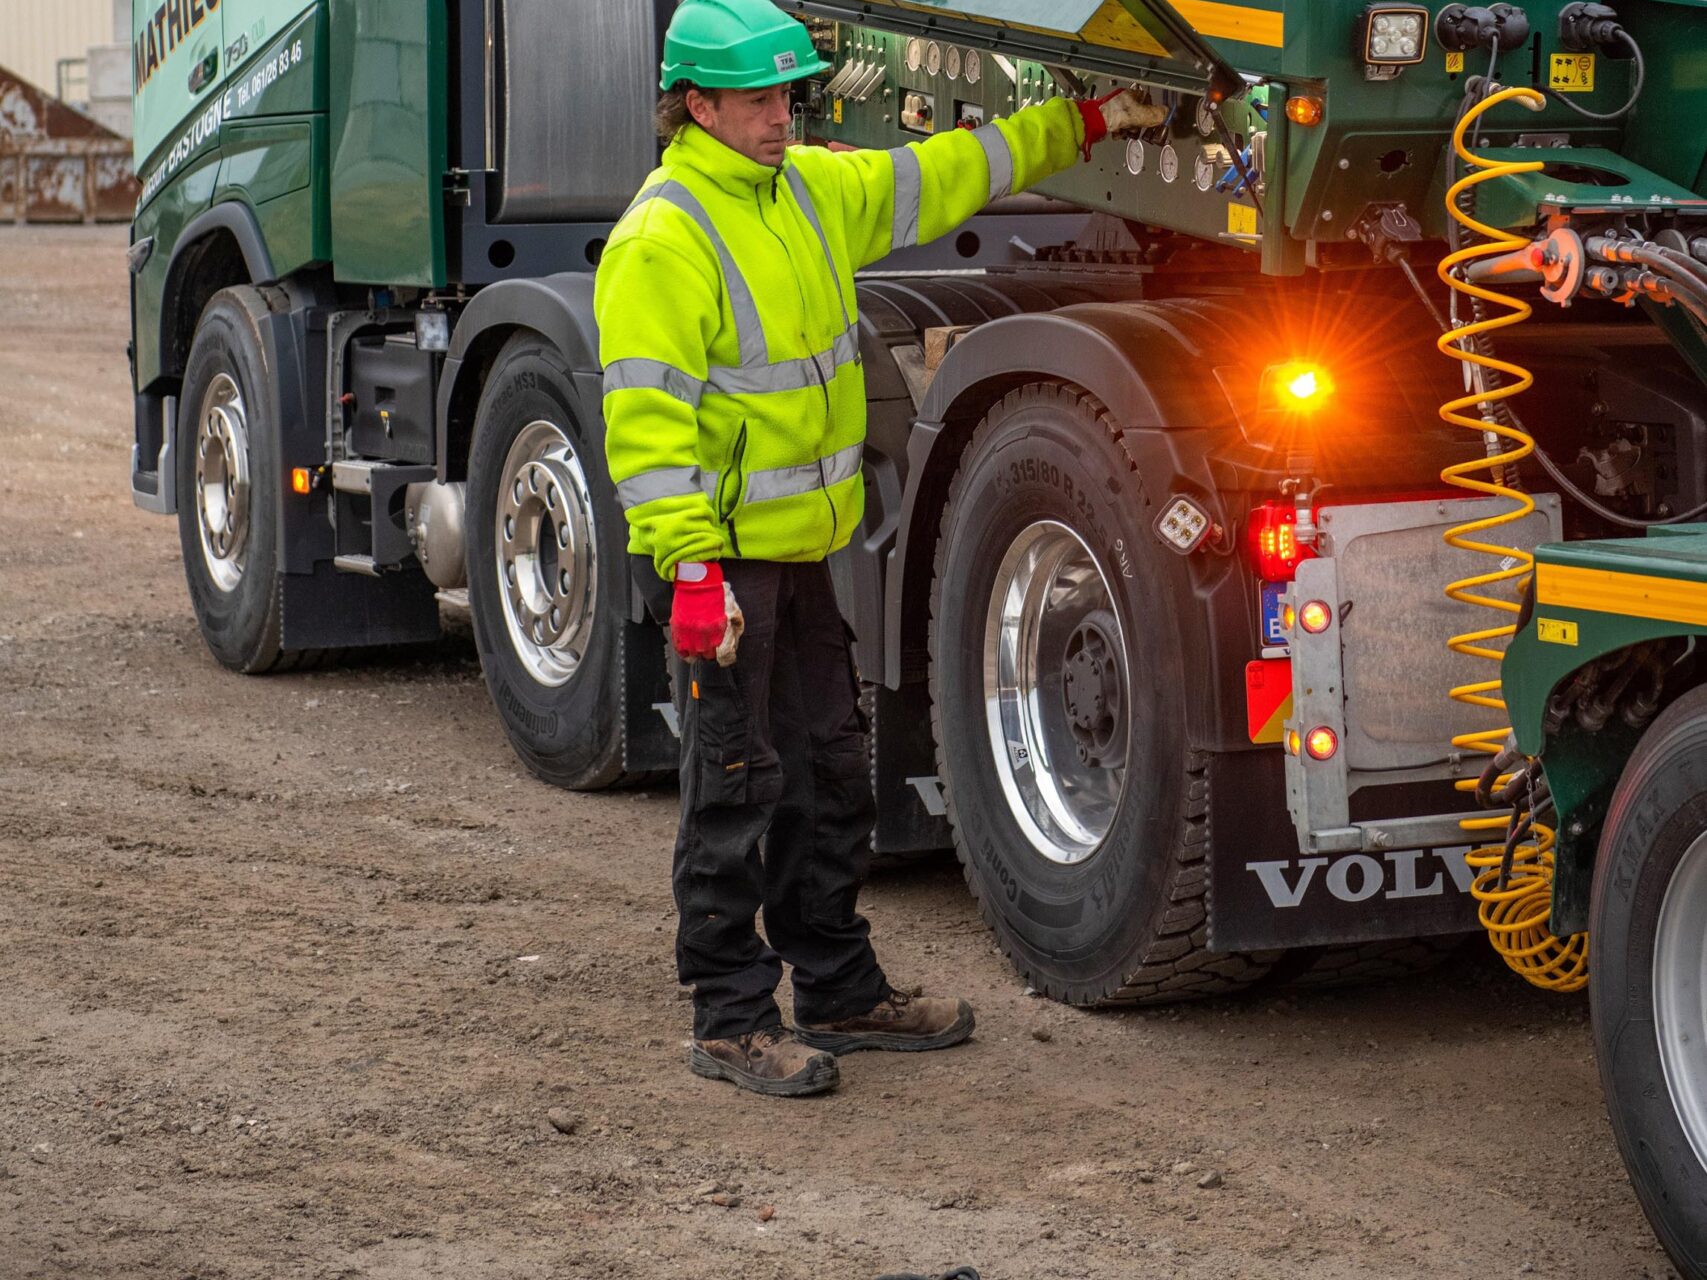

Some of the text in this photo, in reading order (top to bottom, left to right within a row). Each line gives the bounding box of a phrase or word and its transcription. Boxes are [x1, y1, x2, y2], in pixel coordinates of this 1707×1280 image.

[252, 58, 278, 97] 061/28
[279, 48, 290, 75] 83
[290, 39, 302, 65] 46
[514, 372, 536, 393] HS3
[1010, 457, 1060, 489] 315/80
[1063, 474, 1074, 500] R
[499, 680, 559, 739] Continental
[1246, 840, 1550, 908] VOLV
